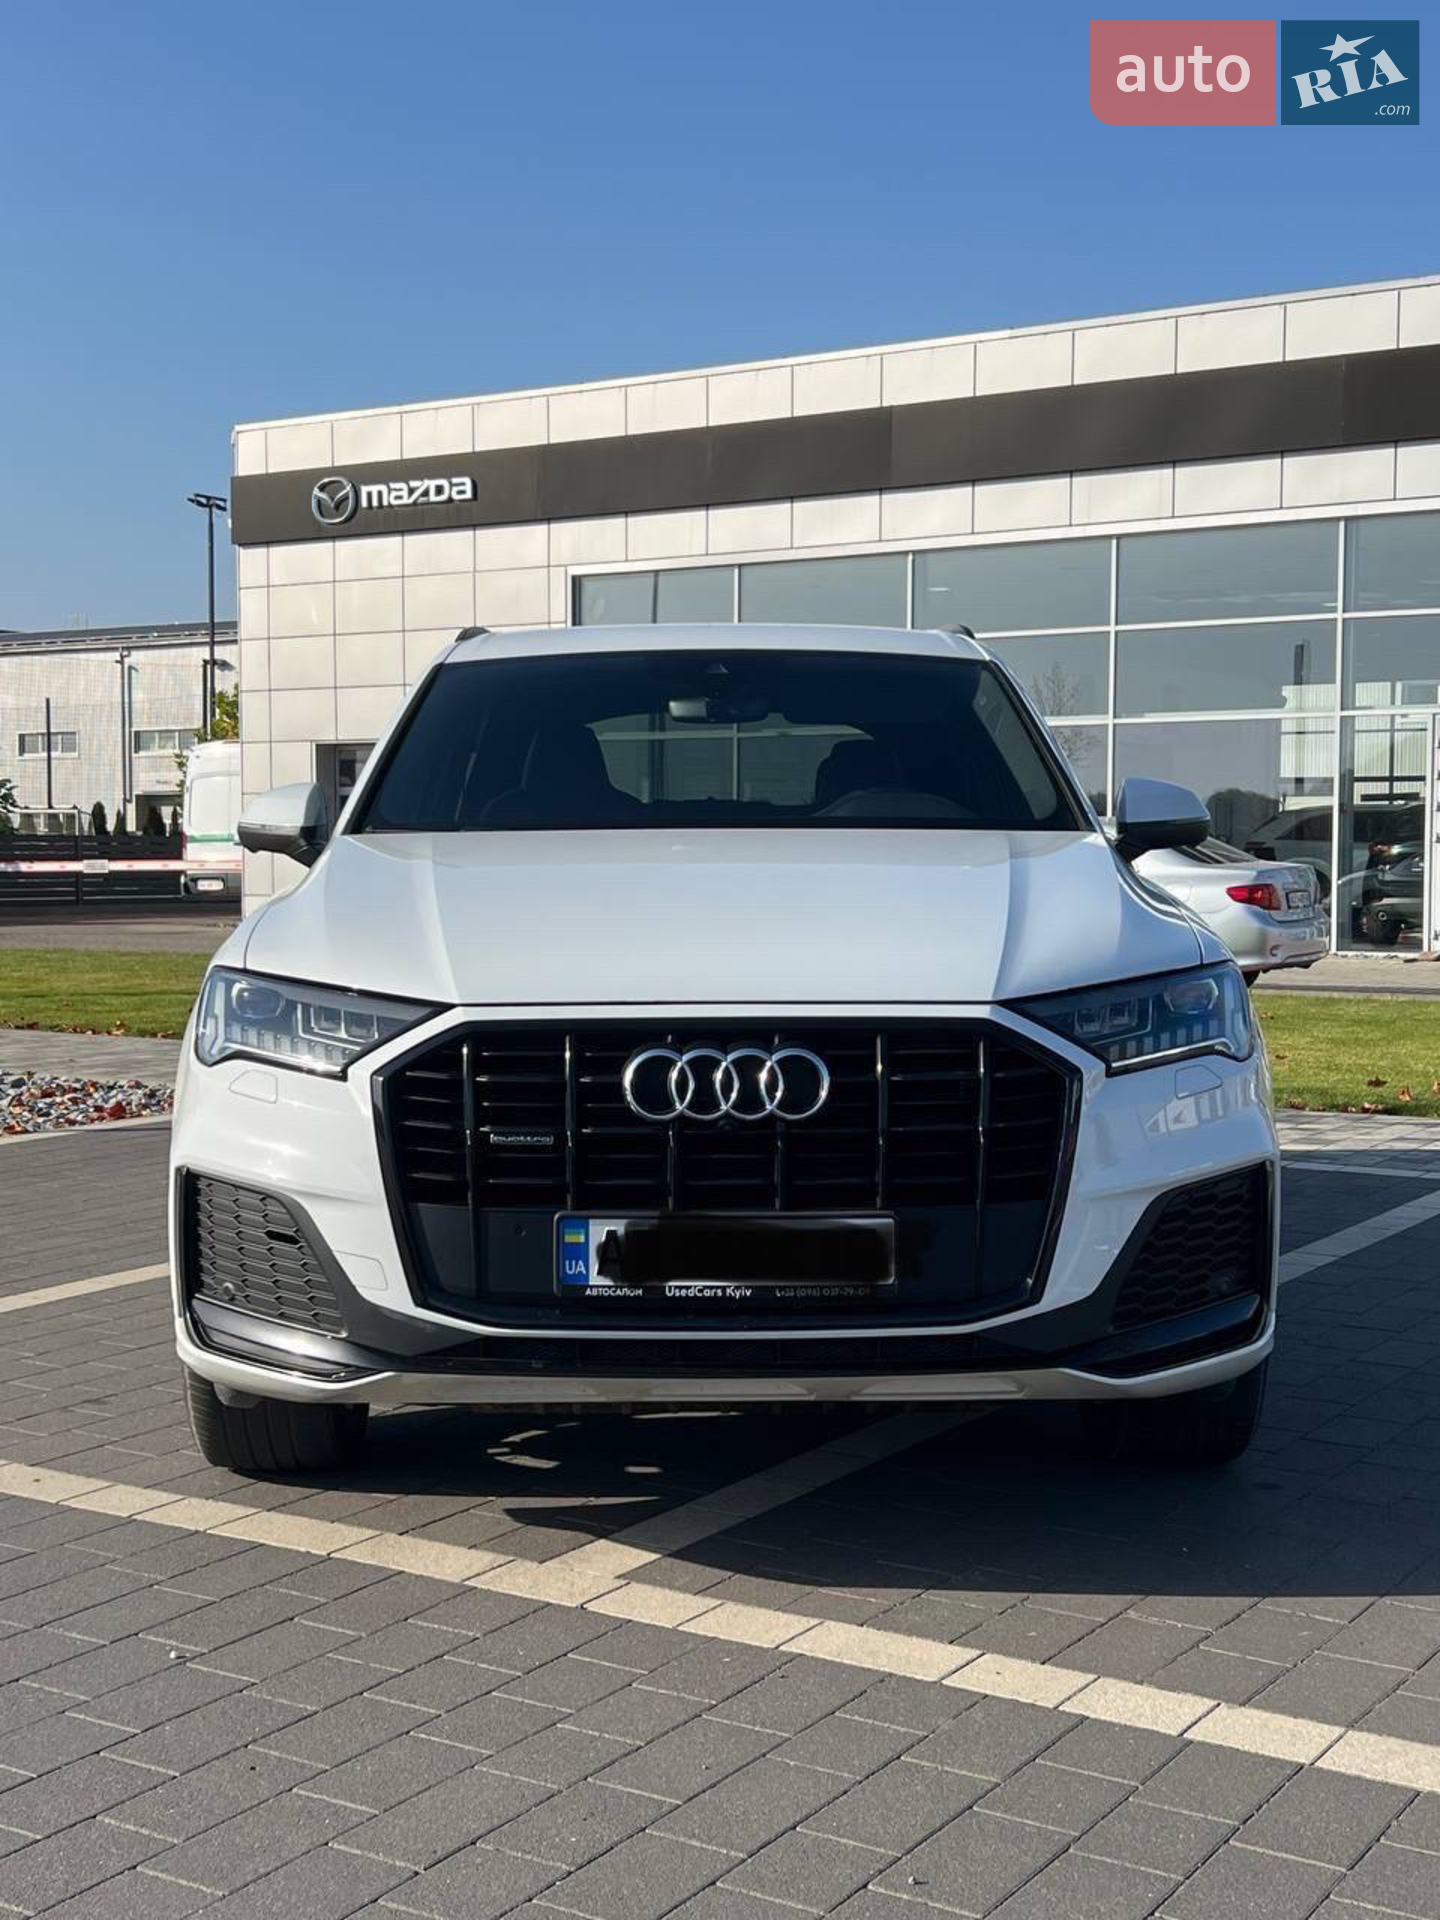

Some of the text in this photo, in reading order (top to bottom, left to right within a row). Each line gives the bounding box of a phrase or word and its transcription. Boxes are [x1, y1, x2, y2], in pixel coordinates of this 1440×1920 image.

[360, 476, 474, 508] mazda
[565, 1260, 586, 1275] UA
[585, 1287, 643, 1297] АВТОСАЛОН
[665, 1286, 752, 1299] UsedCars Kyiv
